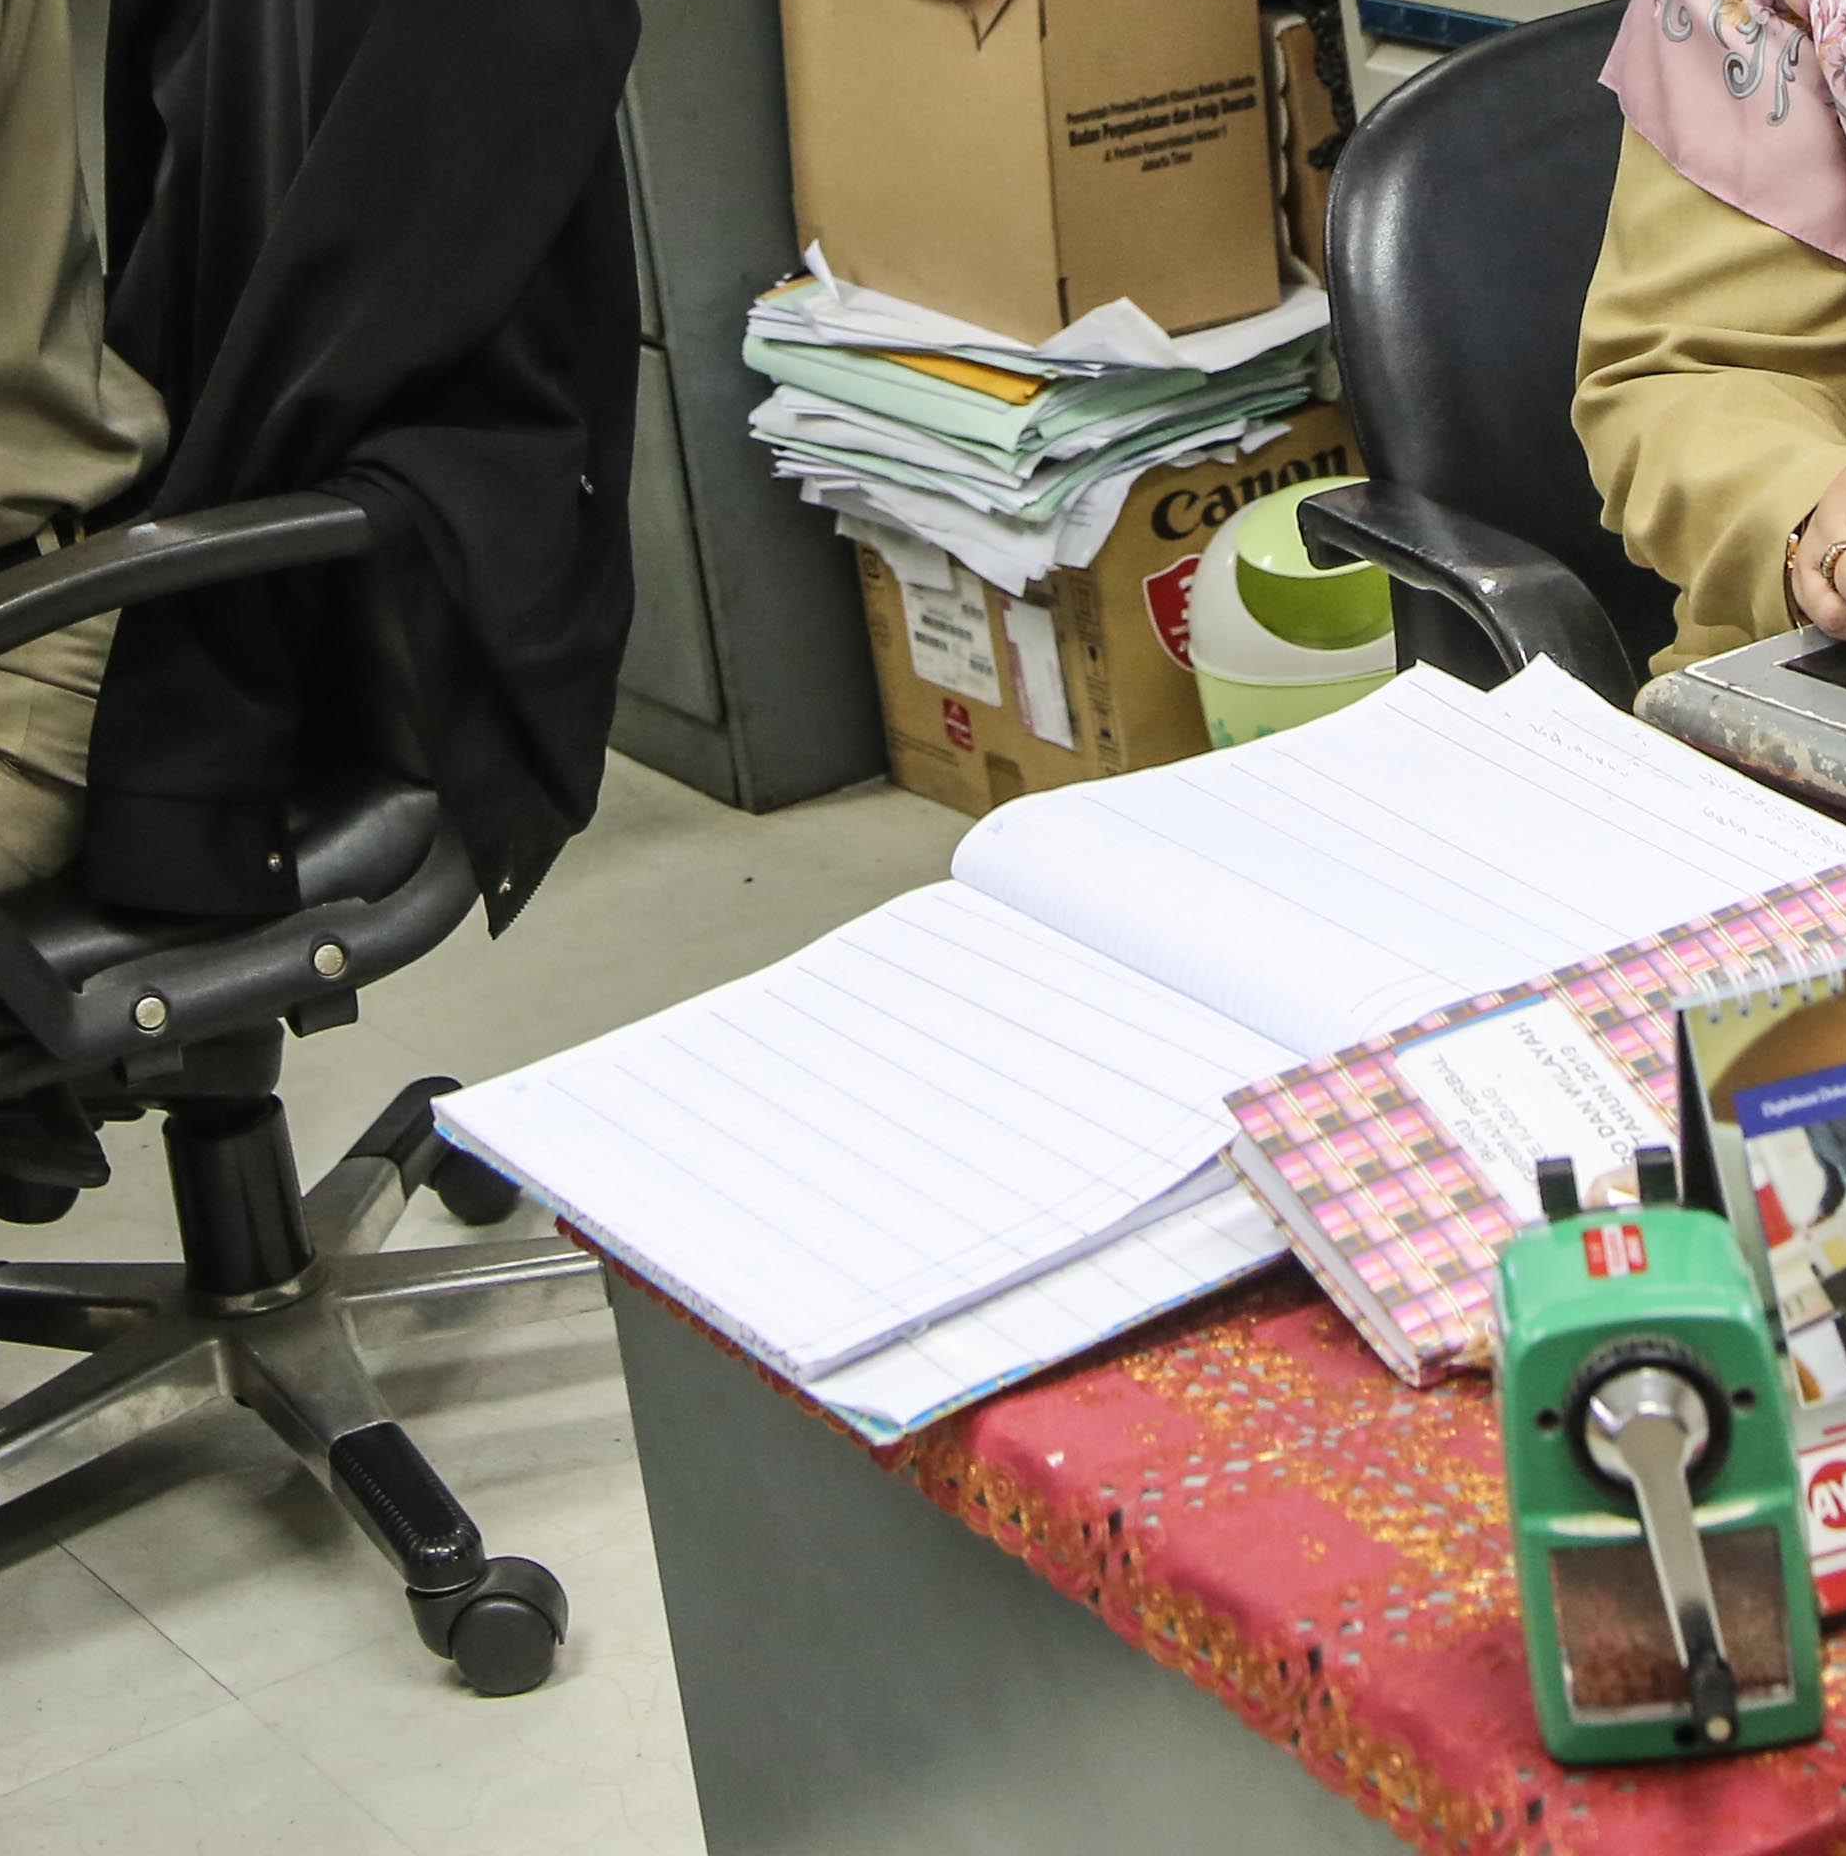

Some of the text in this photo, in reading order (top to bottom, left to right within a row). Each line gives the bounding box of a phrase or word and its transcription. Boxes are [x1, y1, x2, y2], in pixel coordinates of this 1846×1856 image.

[1151, 444, 1349, 541] Canon
[1511, 1019, 1583, 1103] WILAYAH
[1559, 1044, 1648, 1148] TAHUN 2019
[1431, 1052, 1537, 1183] GIRIMAN PERBAL
[1455, 1117, 1498, 1164] BUKU
[1581, 1100, 1617, 1141] DAN
